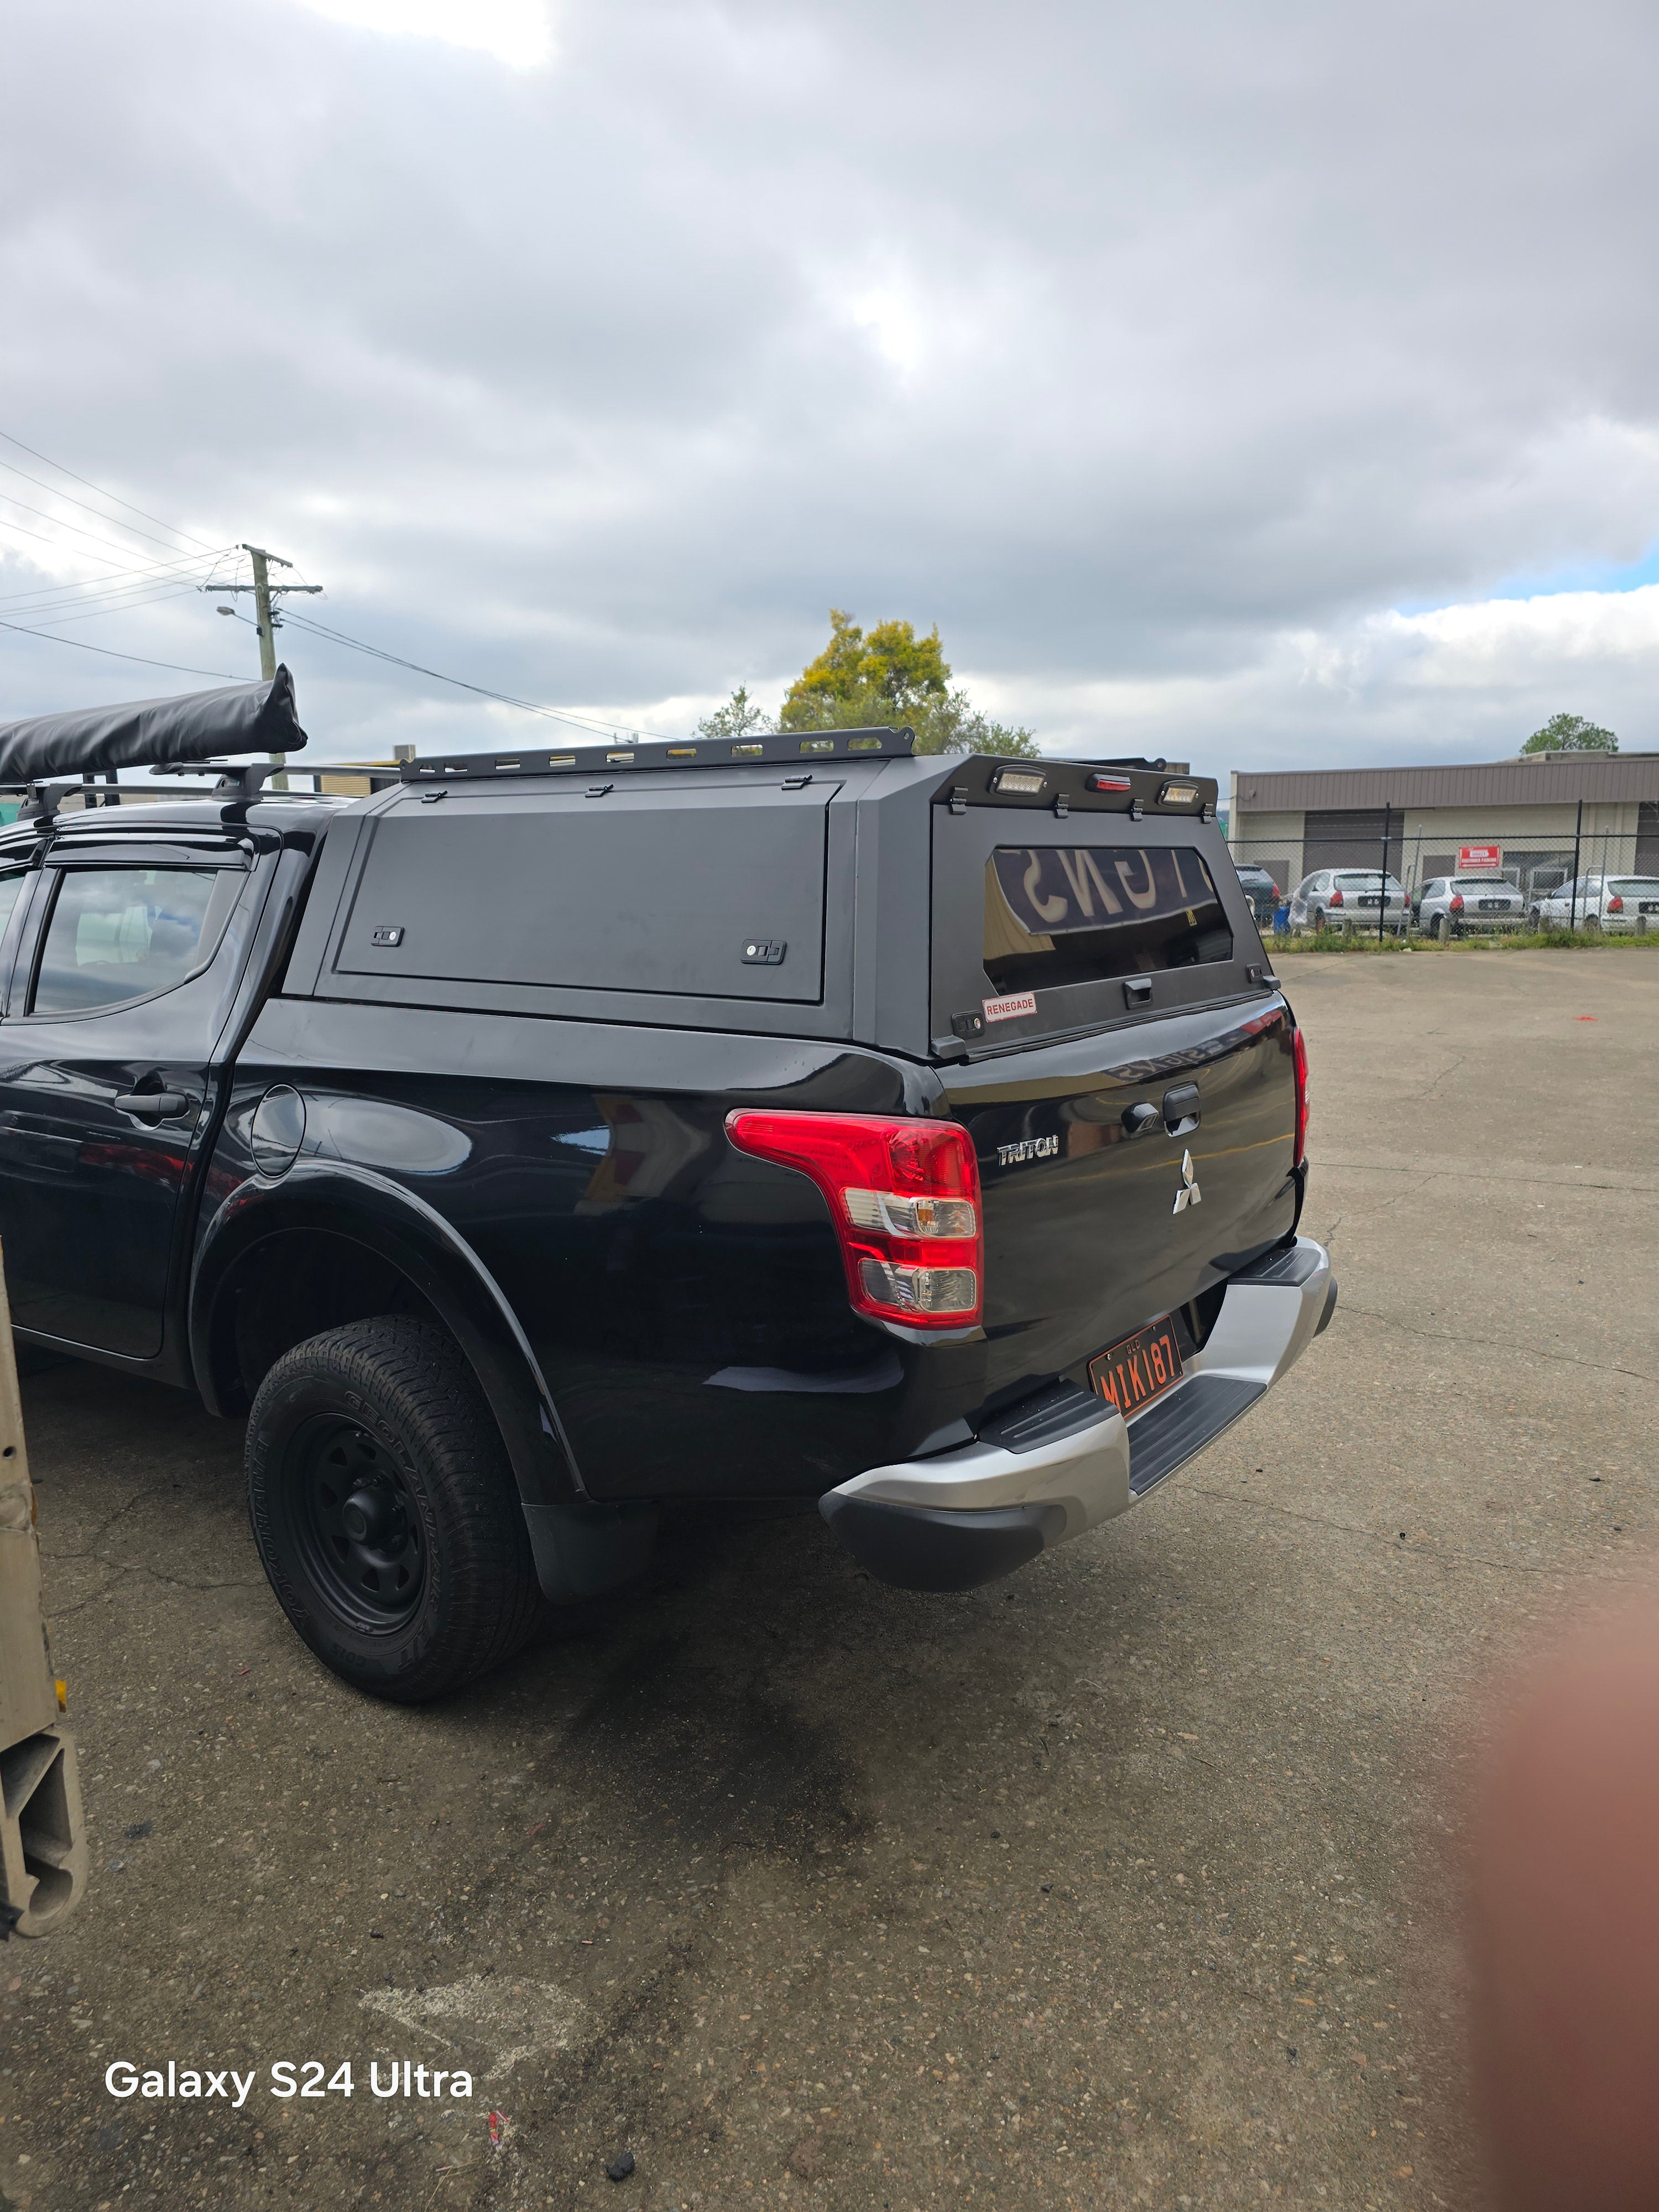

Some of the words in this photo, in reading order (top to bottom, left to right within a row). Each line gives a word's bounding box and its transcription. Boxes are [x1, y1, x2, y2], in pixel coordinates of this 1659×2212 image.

[987, 999, 1034, 1015] RENEGADE
[997, 1135, 1058, 1166] TRITON
[1126, 1339, 1140, 1354] QLD
[253, 1437, 310, 1620] YOKOHAMA
